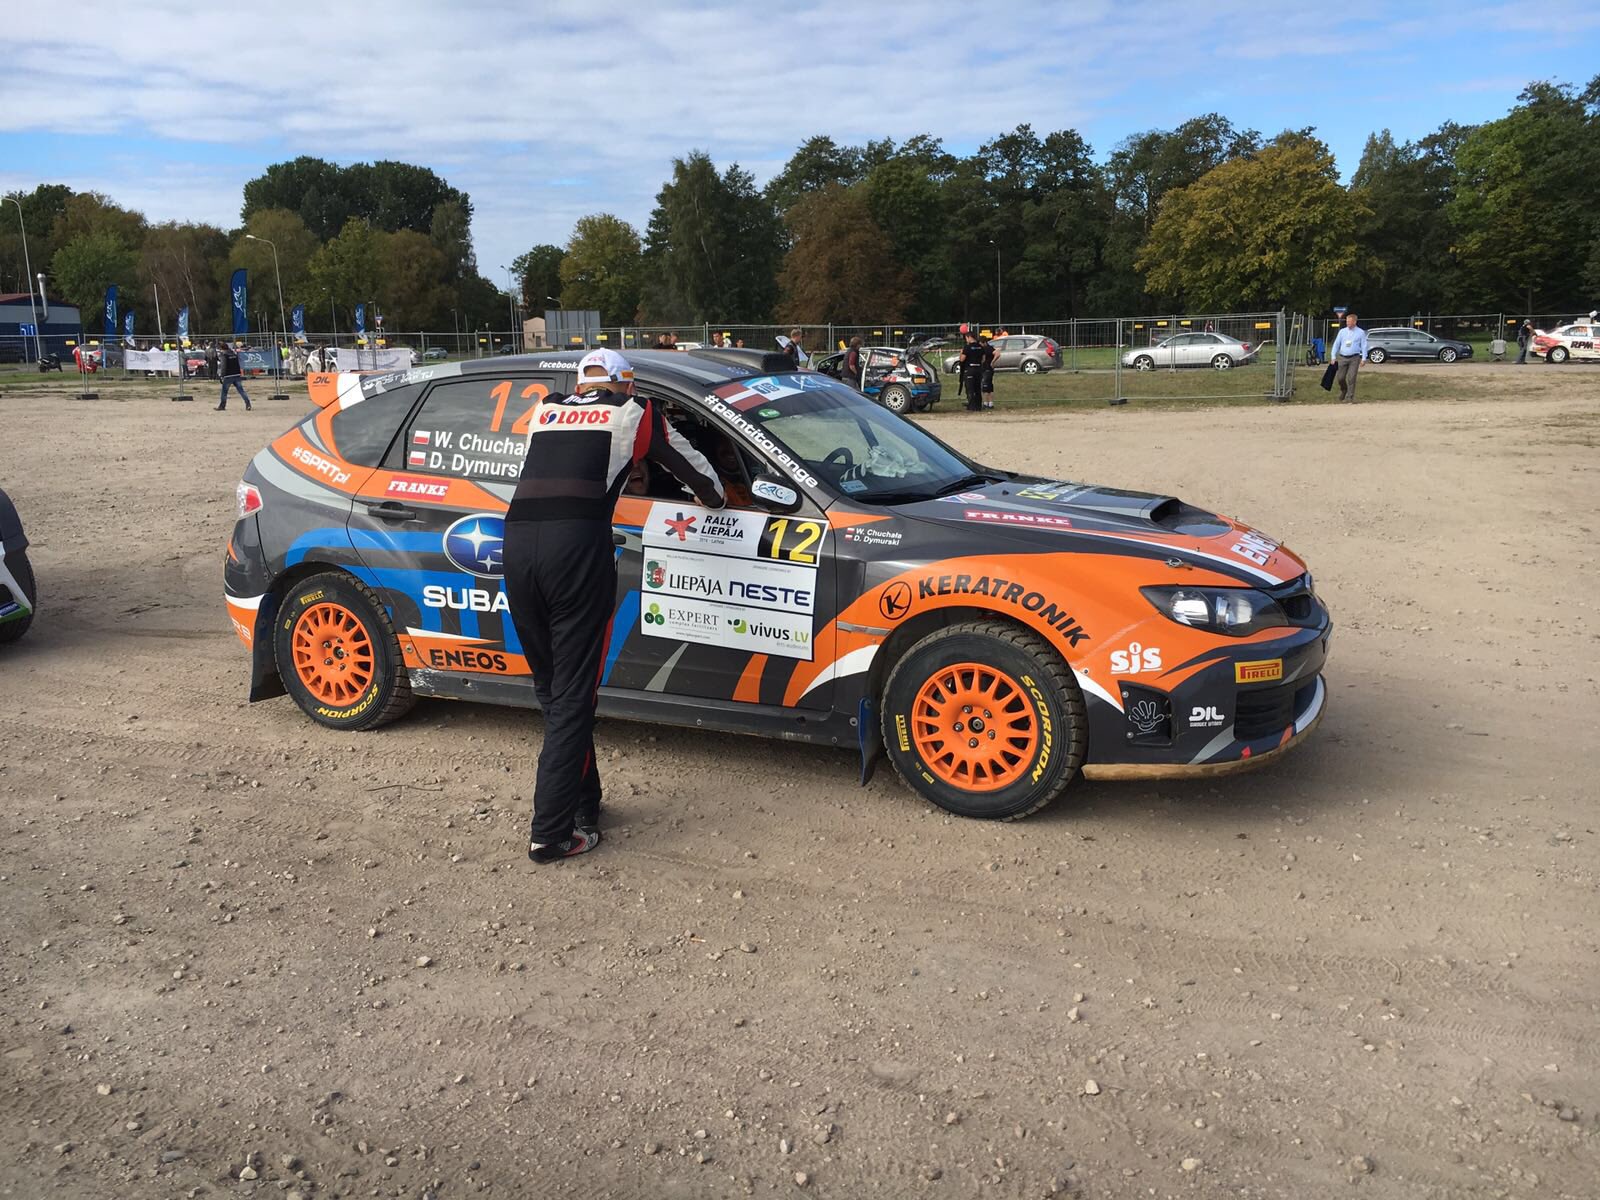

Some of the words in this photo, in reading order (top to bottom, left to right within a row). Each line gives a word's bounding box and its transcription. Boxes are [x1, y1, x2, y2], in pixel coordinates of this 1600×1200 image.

[1570, 340, 1594, 349] RPM
[490, 381, 549, 435] 12
[557, 409, 611, 424] LOTOS
[434, 430, 453, 449] W.
[459, 433, 528, 456] Chucha
[704, 394, 818, 489] #paintitorange
[429, 451, 446, 470] D.
[388, 481, 448, 497] FRANKE
[704, 514, 740, 526] RALLY
[966, 511, 1070, 525] FRANKE
[701, 524, 745, 539] LIEPĀJA
[768, 518, 822, 564] 12
[853, 534, 862, 542] D.
[863, 535, 900, 546] Dymurski
[669, 573, 723, 597] LIEPĀJA
[668, 608, 720, 627] EXPERT
[918, 574, 1091, 649] KERATRONIK
[429, 648, 507, 672] ENEOS
[1240, 662, 1280, 680] PIRELLI
[316, 683, 379, 719] SCORPION
[1188, 706, 1225, 722] DIL
[895, 714, 911, 751] PIRELLI
[1020, 675, 1053, 786] SCORPION
